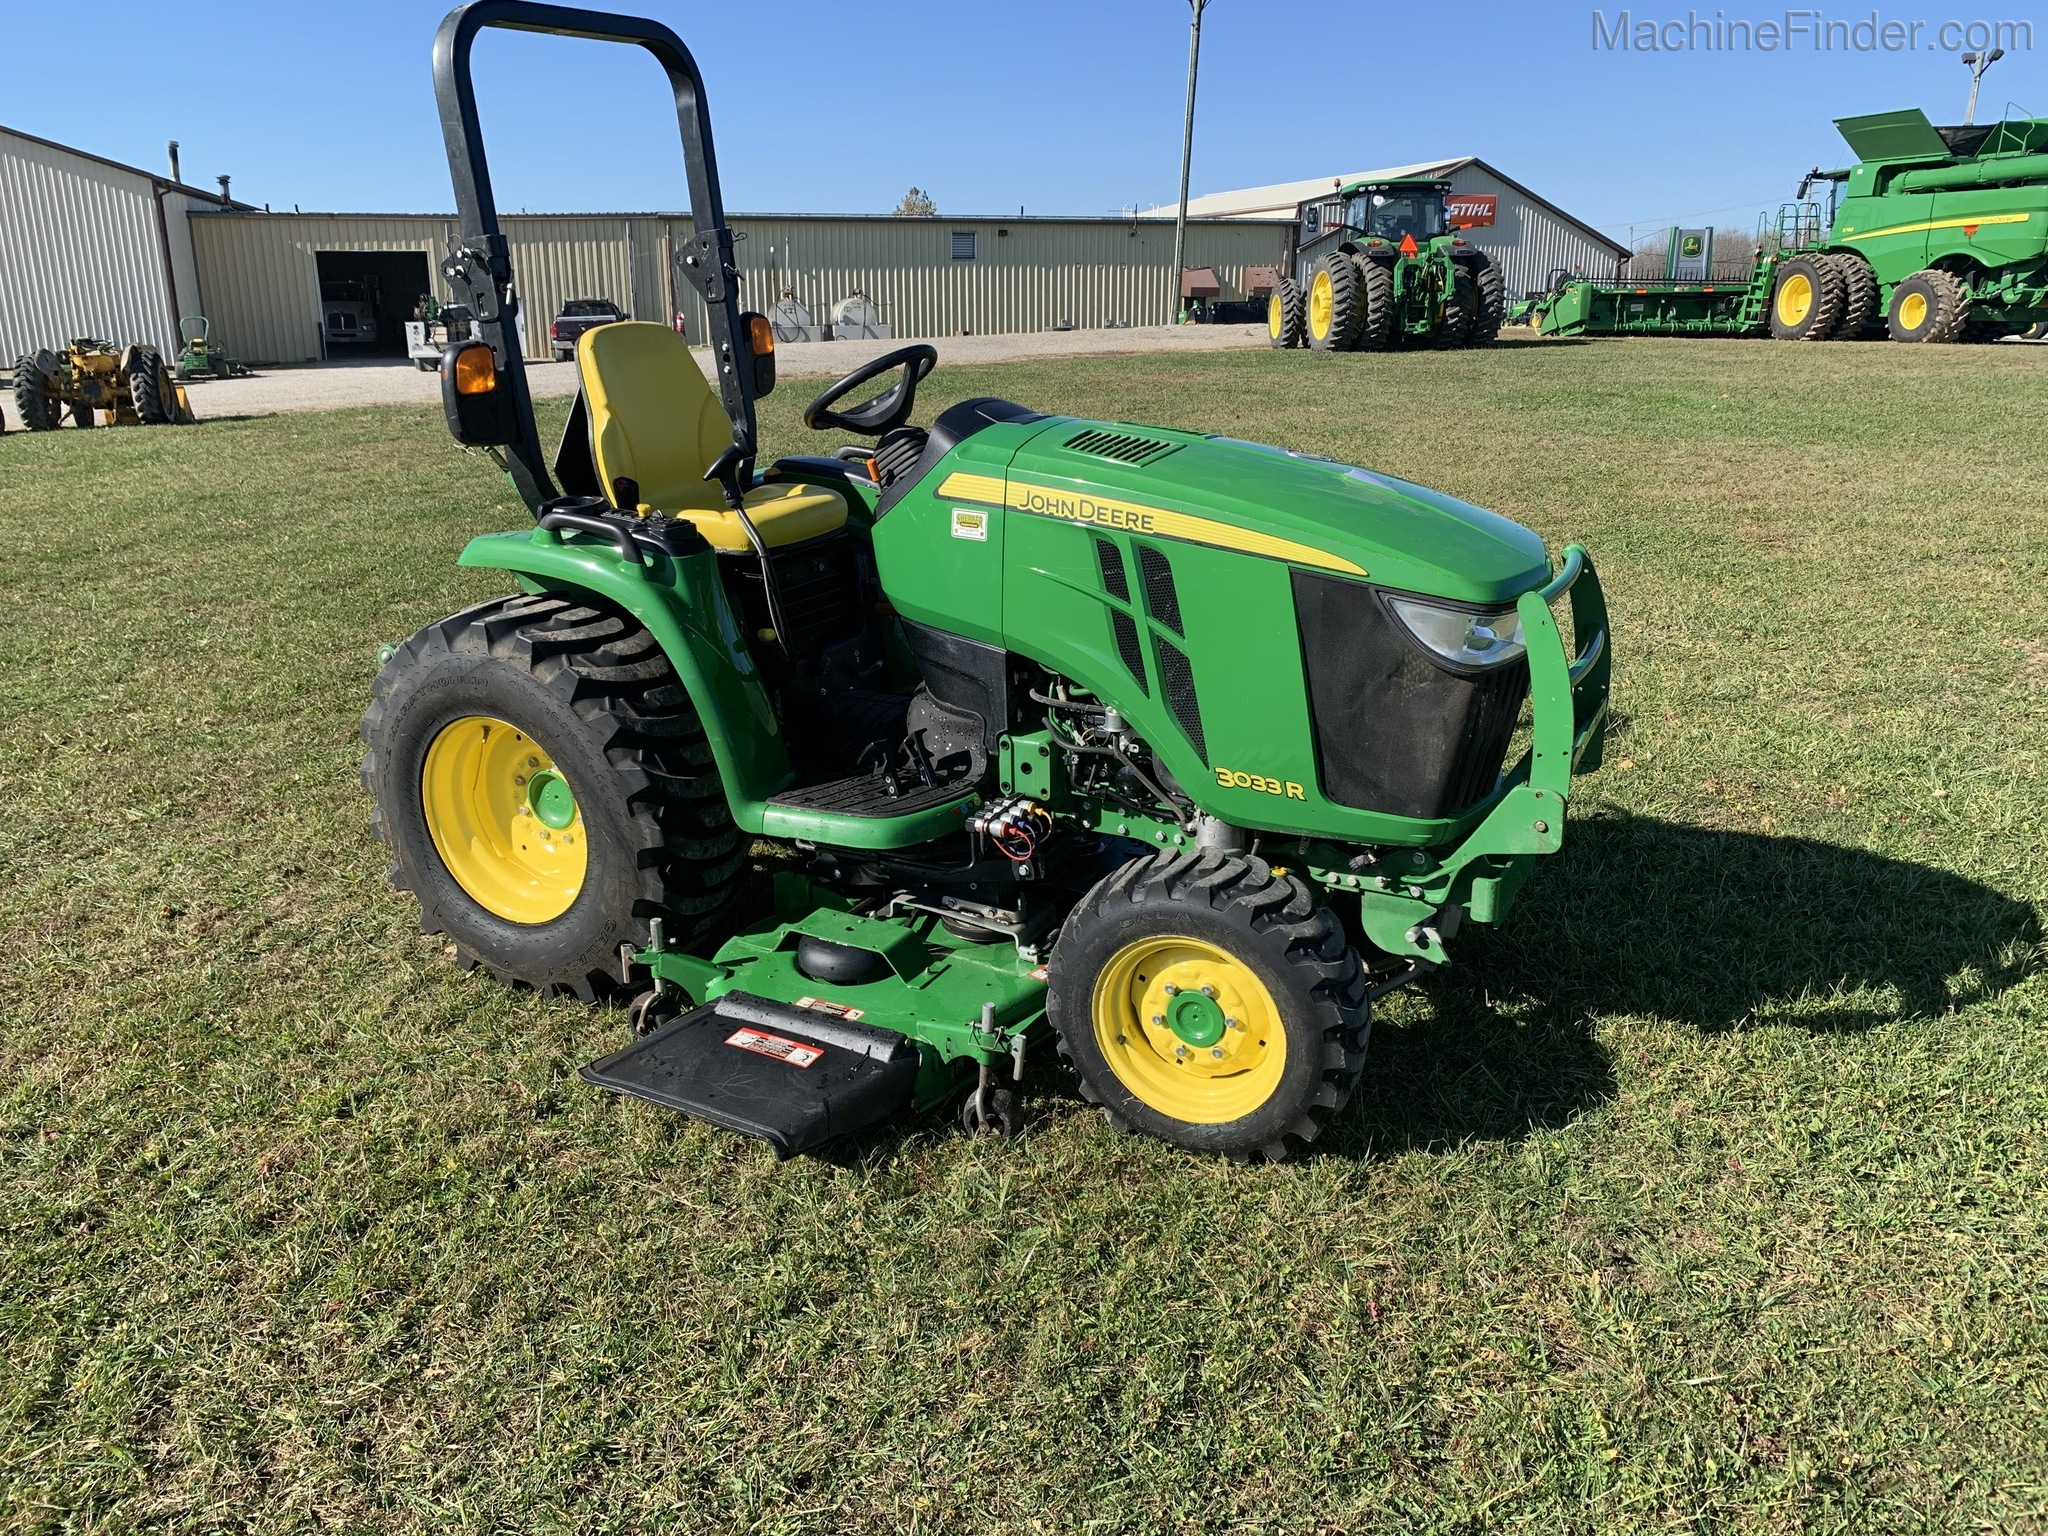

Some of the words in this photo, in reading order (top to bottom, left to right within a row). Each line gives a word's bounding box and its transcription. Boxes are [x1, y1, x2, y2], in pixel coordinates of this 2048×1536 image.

[1450, 203, 1493, 216] STIHL
[1019, 490, 1075, 517] JOHN
[1080, 499, 1154, 531] DEERE
[1214, 766, 1283, 795] 3033
[1284, 780, 1308, 802] R
